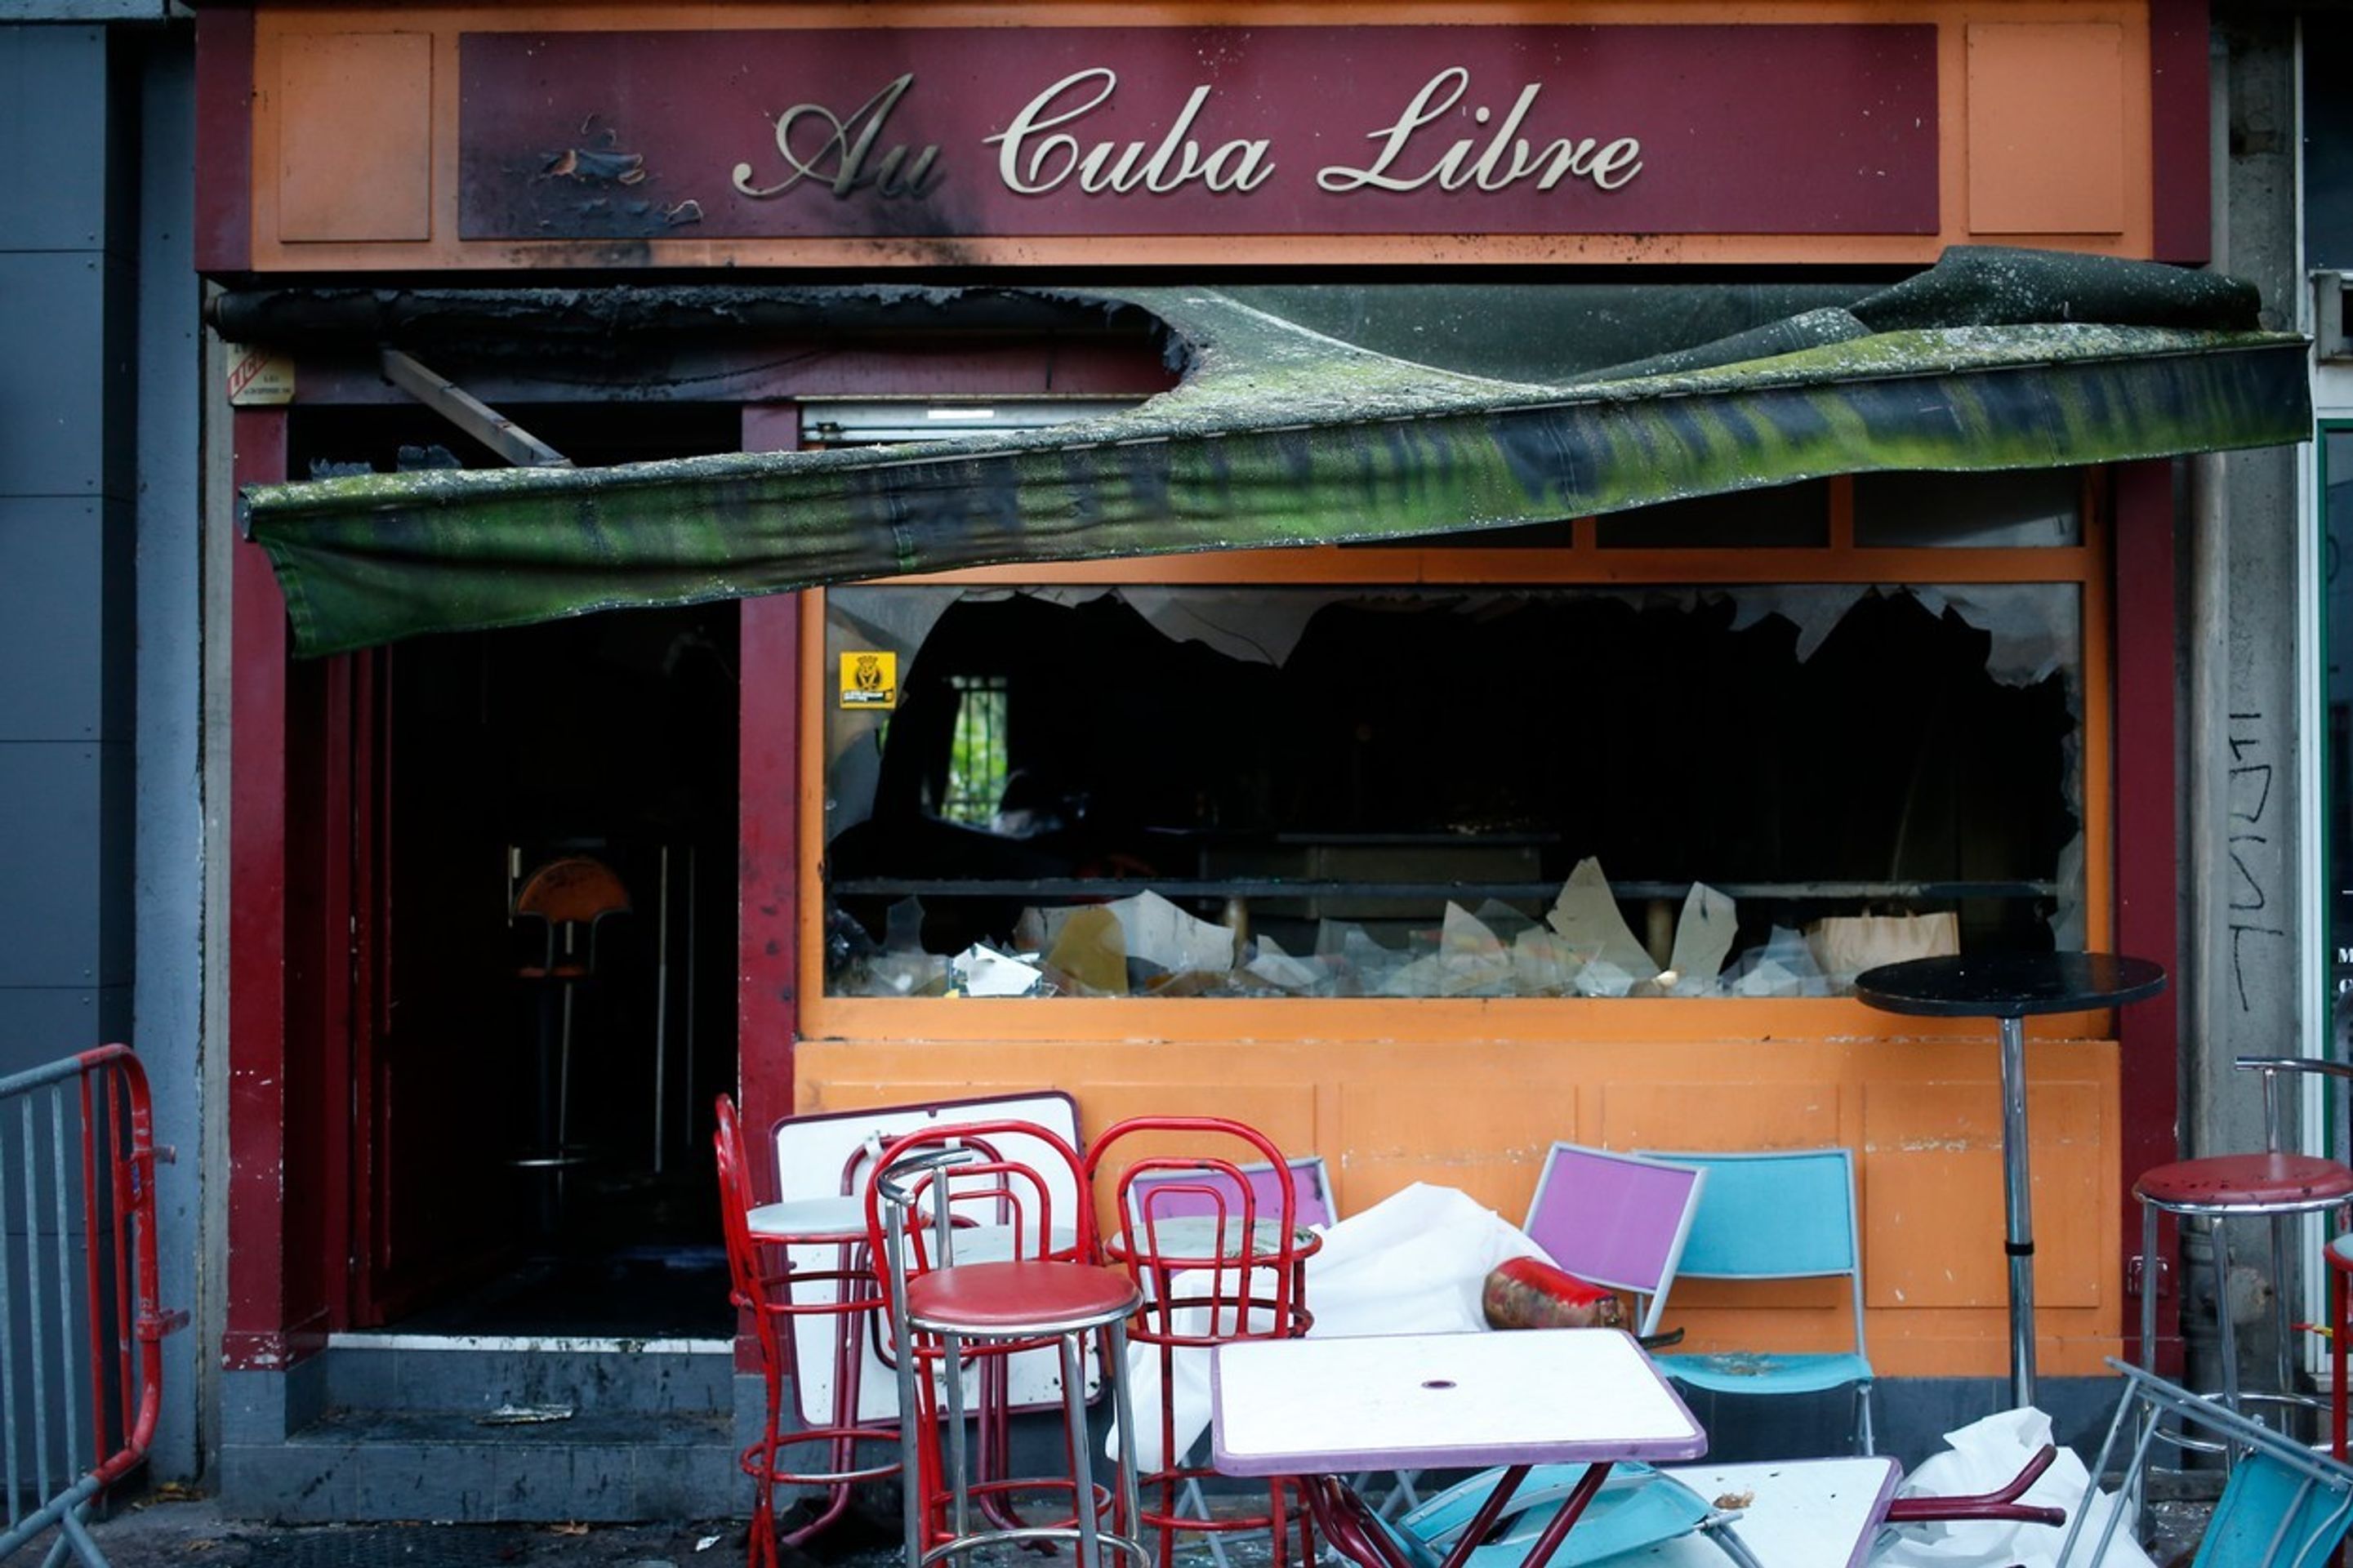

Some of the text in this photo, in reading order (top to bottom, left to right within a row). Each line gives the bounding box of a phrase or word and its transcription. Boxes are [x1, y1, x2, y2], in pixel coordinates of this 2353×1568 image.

[732, 66, 1643, 196] Au Cuba Libre
